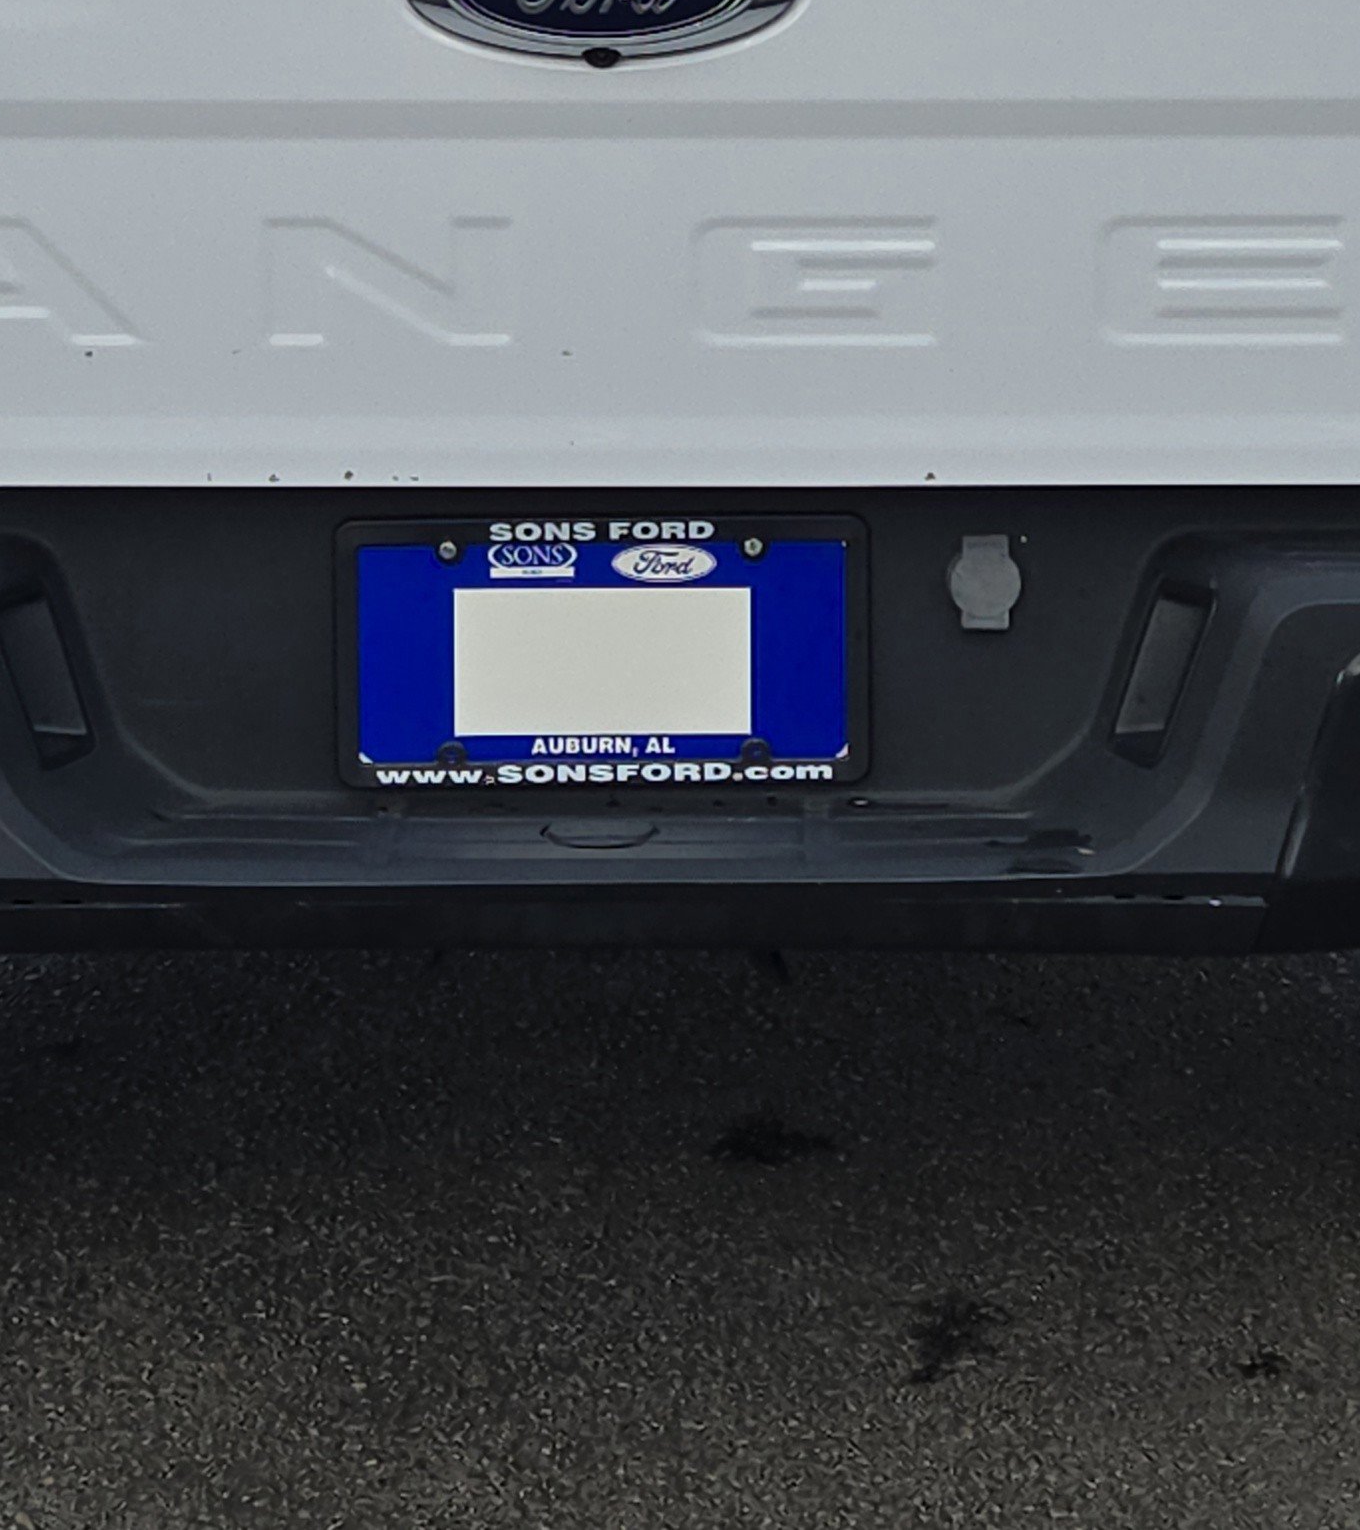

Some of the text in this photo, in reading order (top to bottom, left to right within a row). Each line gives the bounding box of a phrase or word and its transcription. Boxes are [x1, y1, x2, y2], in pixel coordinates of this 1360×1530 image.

[489, 521, 716, 542] SONS FORD
[499, 544, 564, 567] SONS
[632, 550, 695, 576] Ford
[531, 736, 676, 757] AUBURN, AL
[376, 761, 833, 786] www.SONSFORD.com
